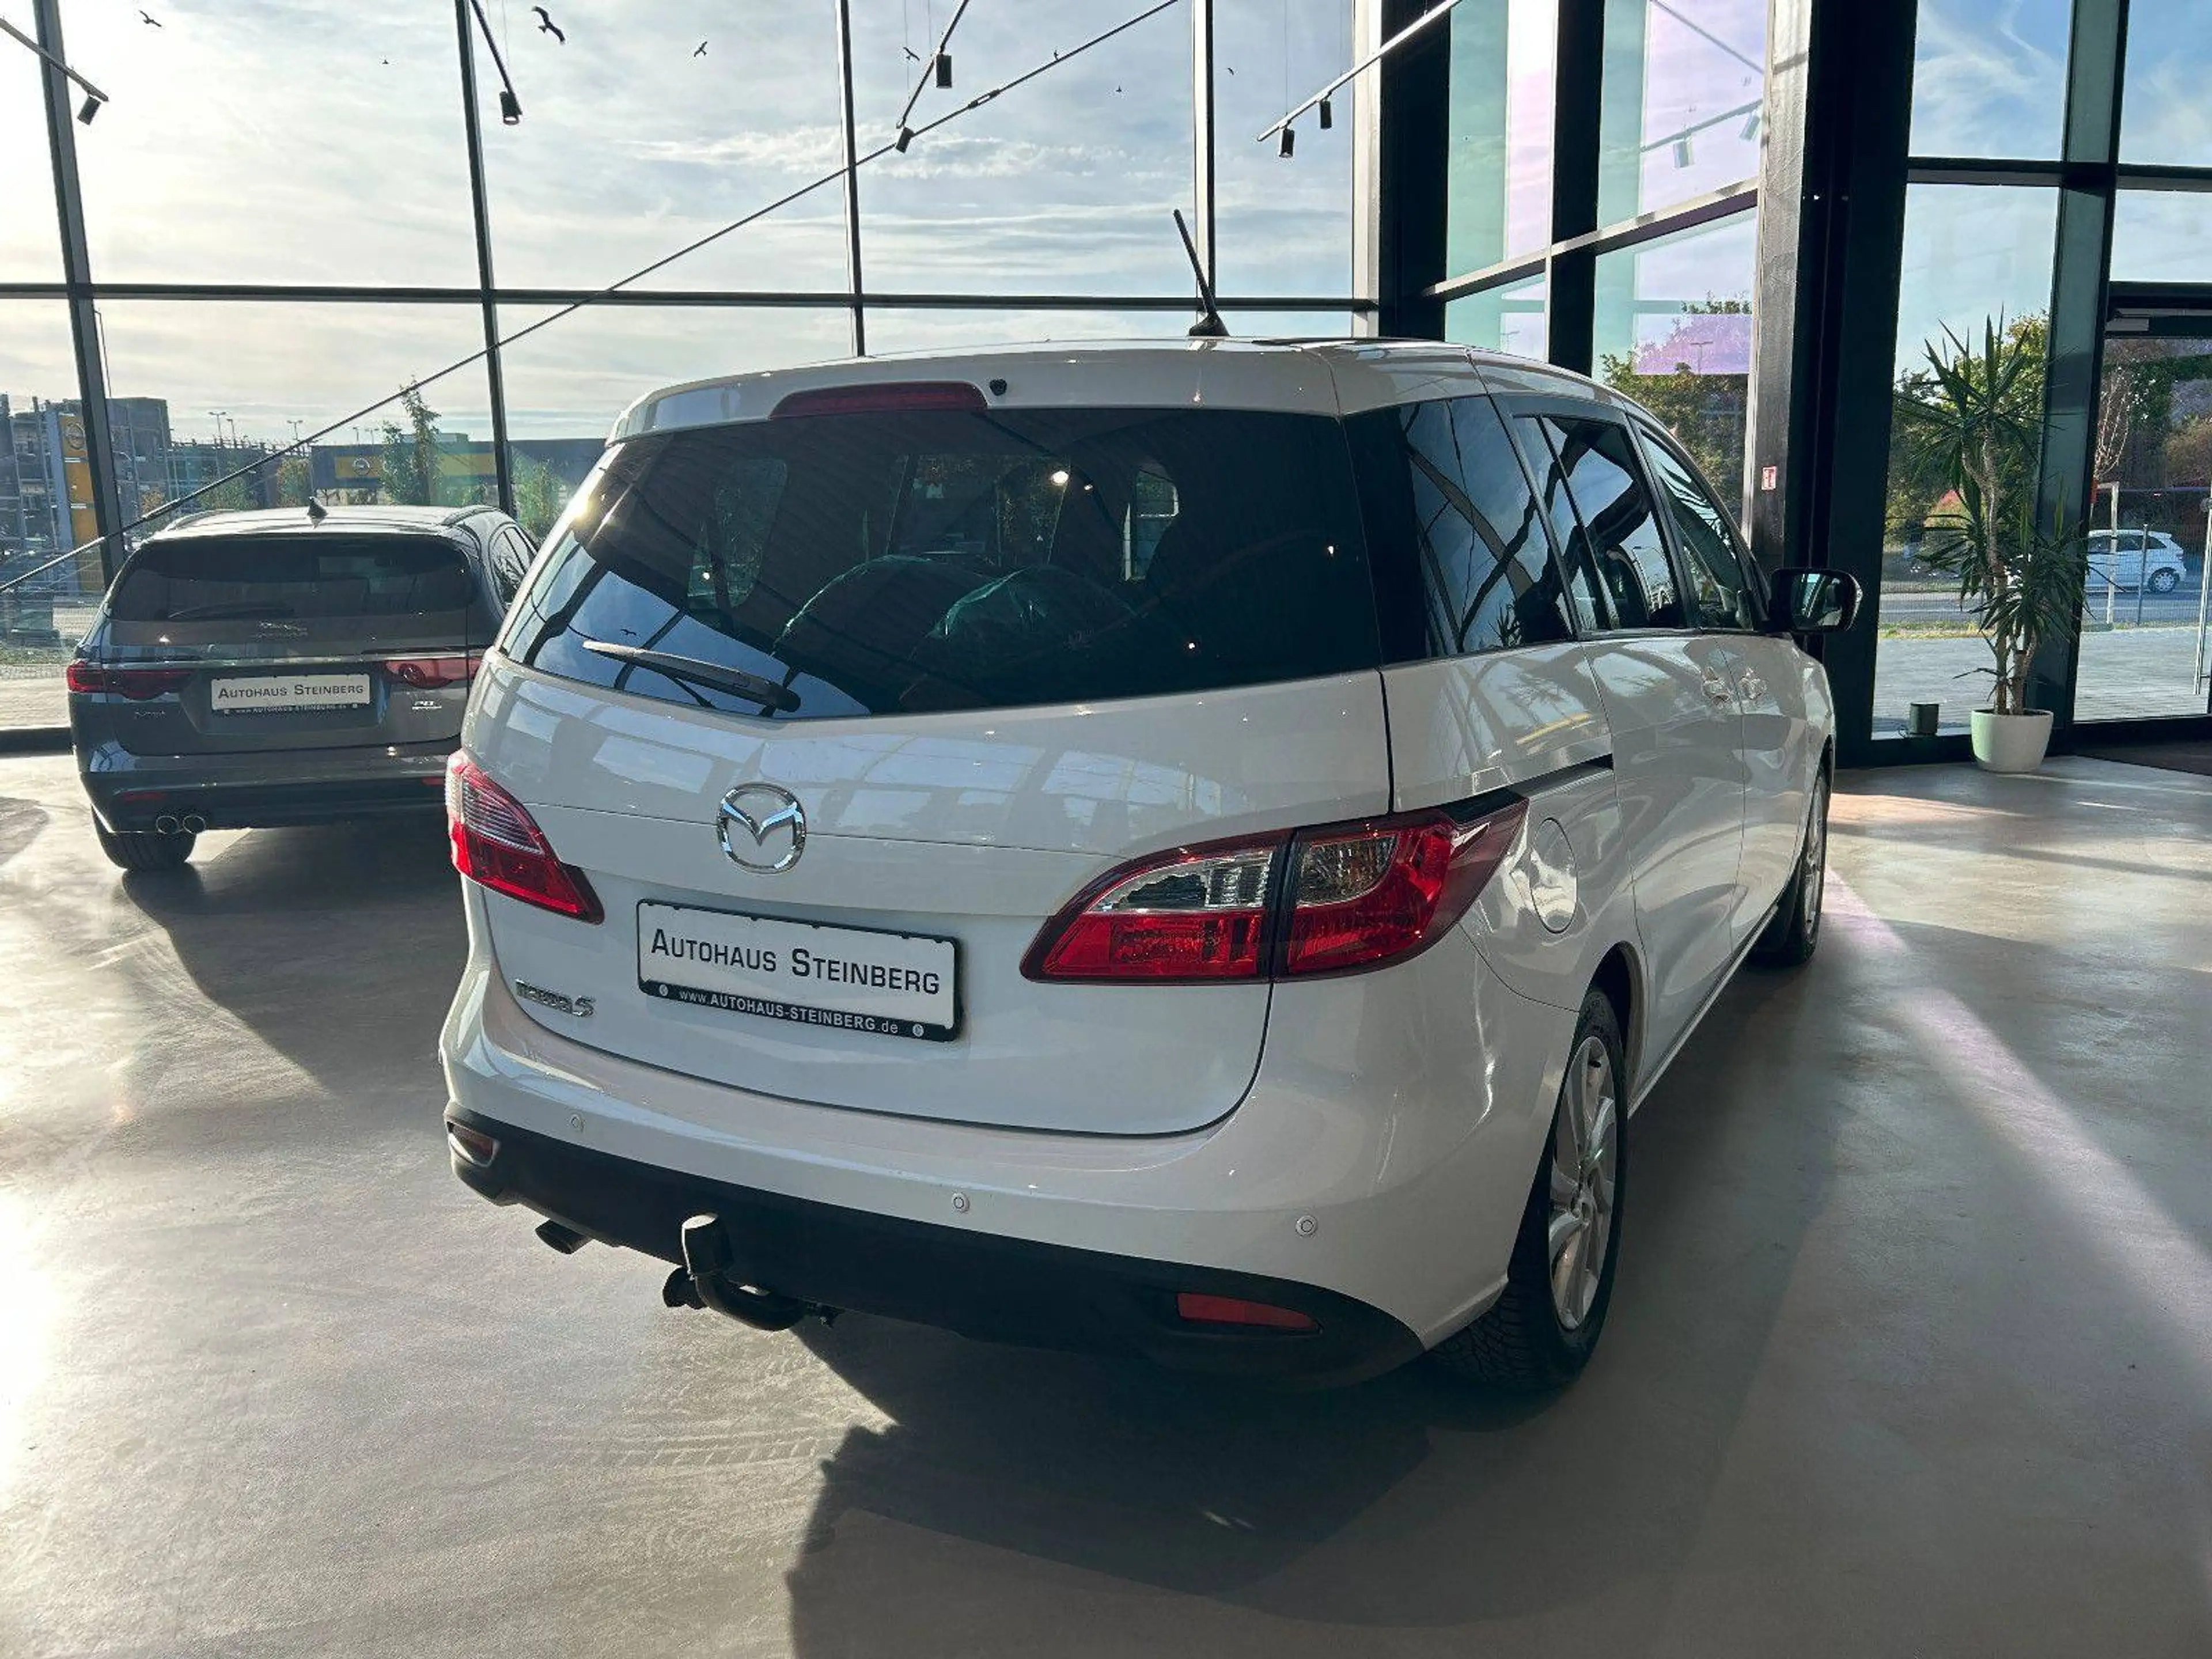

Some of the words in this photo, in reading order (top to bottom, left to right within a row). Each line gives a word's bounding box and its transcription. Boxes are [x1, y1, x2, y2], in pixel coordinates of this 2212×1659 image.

[218, 687, 287, 699] AUTOHAUS
[294, 684, 363, 695] STEINBERG
[651, 929, 777, 972] AUTOHAUS
[792, 948, 940, 995] STEINBERG
[679, 990, 899, 1033] www.AUTOHAUS-STEINBERG.de
